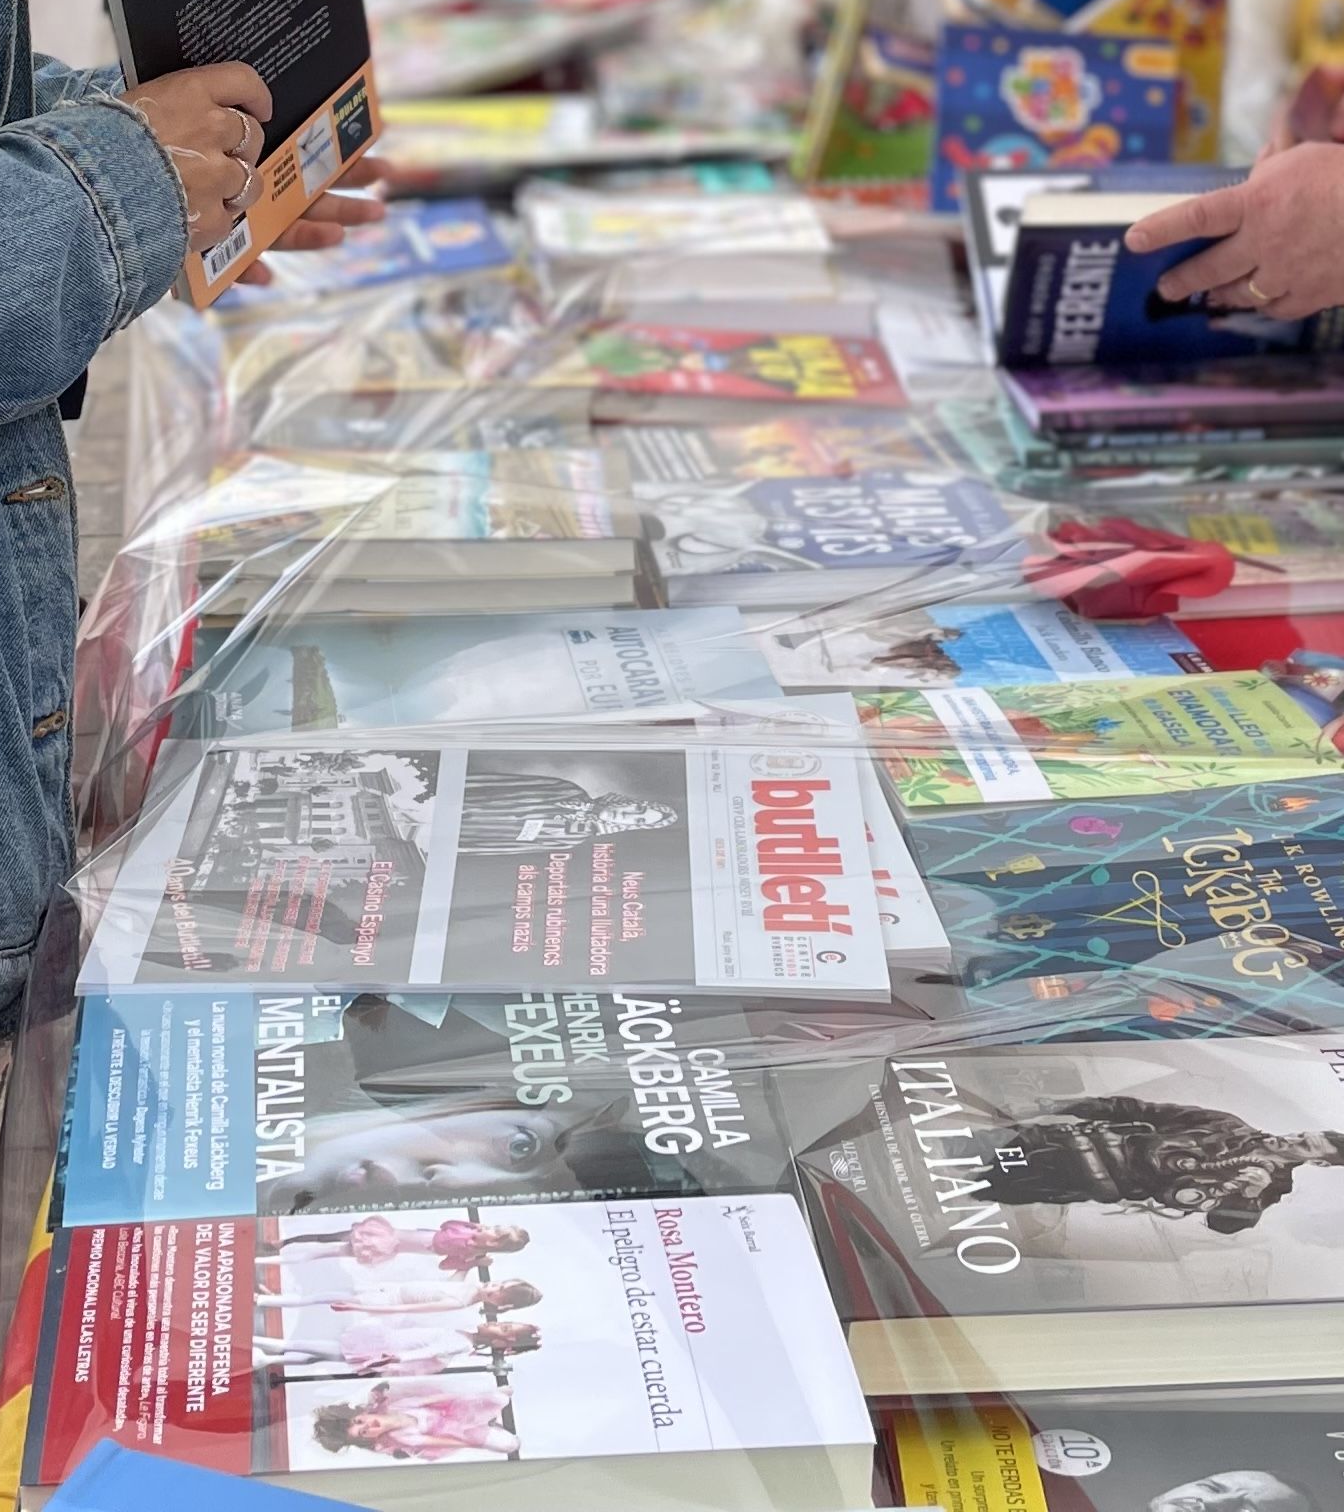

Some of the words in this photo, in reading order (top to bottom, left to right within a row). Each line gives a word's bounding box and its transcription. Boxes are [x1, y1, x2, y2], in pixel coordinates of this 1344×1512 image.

[578, 660, 602, 681] POR
[372, 861, 393, 870] El
[518, 865, 539, 880] als
[592, 844, 614, 882] història
[751, 780, 853, 936] butlletí
[364, 873, 390, 911] Casino
[545, 853, 570, 905] Deportats
[622, 872, 645, 899] Neus
[1256, 869, 1288, 896] THE
[172, 903, 194, 920] del
[512, 882, 534, 919] camps
[590, 885, 614, 916] d'una
[512, 922, 535, 952] nazis
[544, 908, 568, 966] rubinencs
[619, 902, 646, 942] Català,
[350, 914, 383, 966] Espanyol
[590, 919, 614, 976] lluitadora
[797, 936, 812, 978] CENTRE
[212, 1001, 229, 1012] La
[312, 995, 342, 1016] EL
[187, 1028, 204, 1037] el
[210, 1014, 226, 1043] nueva
[110, 1029, 127, 1068] ATRÉVETE
[186, 1038, 204, 1091] mentalista
[210, 1045, 229, 1079] novela
[210, 1080, 228, 1094] de
[256, 997, 304, 1182] MENTALISTA
[613, 992, 704, 1154] ÄCKBERG
[106, 1076, 122, 1122] DESCUBRIR
[686, 1048, 752, 1148] CAMILLA
[868, 1084, 884, 1100] UNA
[185, 1093, 203, 1128] Henrik
[210, 1095, 230, 1134] Camilla
[874, 1101, 895, 1142] HISTORIA
[104, 1122, 118, 1133] LA
[102, 1134, 118, 1169] VERDAD
[183, 1130, 202, 1169] Fexeus
[206, 1135, 229, 1190] Läckberg
[886, 1143, 898, 1155] DE
[994, 1146, 1028, 1174] EL
[840, 1140, 868, 1194] ALFAGUARA
[890, 1060, 1021, 1275] ITALIANO
[900, 1186, 914, 1206] MAR
[606, 1210, 638, 1224] El
[654, 1208, 683, 1247] Rosa
[908, 1213, 932, 1248] GUERRA
[88, 1228, 106, 1259] PREMIO
[195, 1224, 213, 1246] DEL
[218, 1222, 235, 1246] UNA
[128, 1254, 142, 1289] inoculado
[165, 1246, 178, 1275] Montero
[193, 1247, 212, 1289] VALOR
[602, 1228, 644, 1282] peligro
[83, 1260, 103, 1308] NACIONAL
[112, 1272, 126, 1289] ABC
[162, 1276, 176, 1316] demuestra
[214, 1250, 234, 1332] APASIONADA
[665, 1251, 706, 1333] Montero
[125, 1298, 138, 1318] virus
[146, 1289, 160, 1330] personales
[191, 1292, 210, 1309] DE
[625, 1288, 655, 1307] de
[79, 1324, 96, 1343] LAS
[81, 1310, 96, 1324] DE
[124, 1318, 136, 1328] de
[160, 1317, 172, 1332] una
[190, 1310, 208, 1336] SER
[628, 1312, 661, 1355] estar
[122, 1330, 134, 1344] una
[143, 1342, 156, 1364] obras
[145, 1332, 156, 1342] en
[158, 1333, 172, 1366] maestría
[74, 1344, 93, 1383] LETRAS
[118, 1345, 133, 1386] curiosidad
[142, 1365, 154, 1376] de
[157, 1367, 171, 1386] total
[186, 1339, 207, 1412] DIFERENTE
[212, 1334, 232, 1396] DEFENSA
[641, 1359, 682, 1429] cuerda
[152, 1395, 168, 1444] transformar
[991, 1426, 1013, 1442] NO
[940, 1440, 957, 1453] Un
[995, 1443, 1015, 1456] TE
[1039, 1433, 1062, 1470] EDICIÓN
[944, 1454, 960, 1477] relato
[970, 1470, 988, 1484] Un
[998, 1458, 1027, 1506] PIERDAS
[947, 1478, 960, 1490] en
